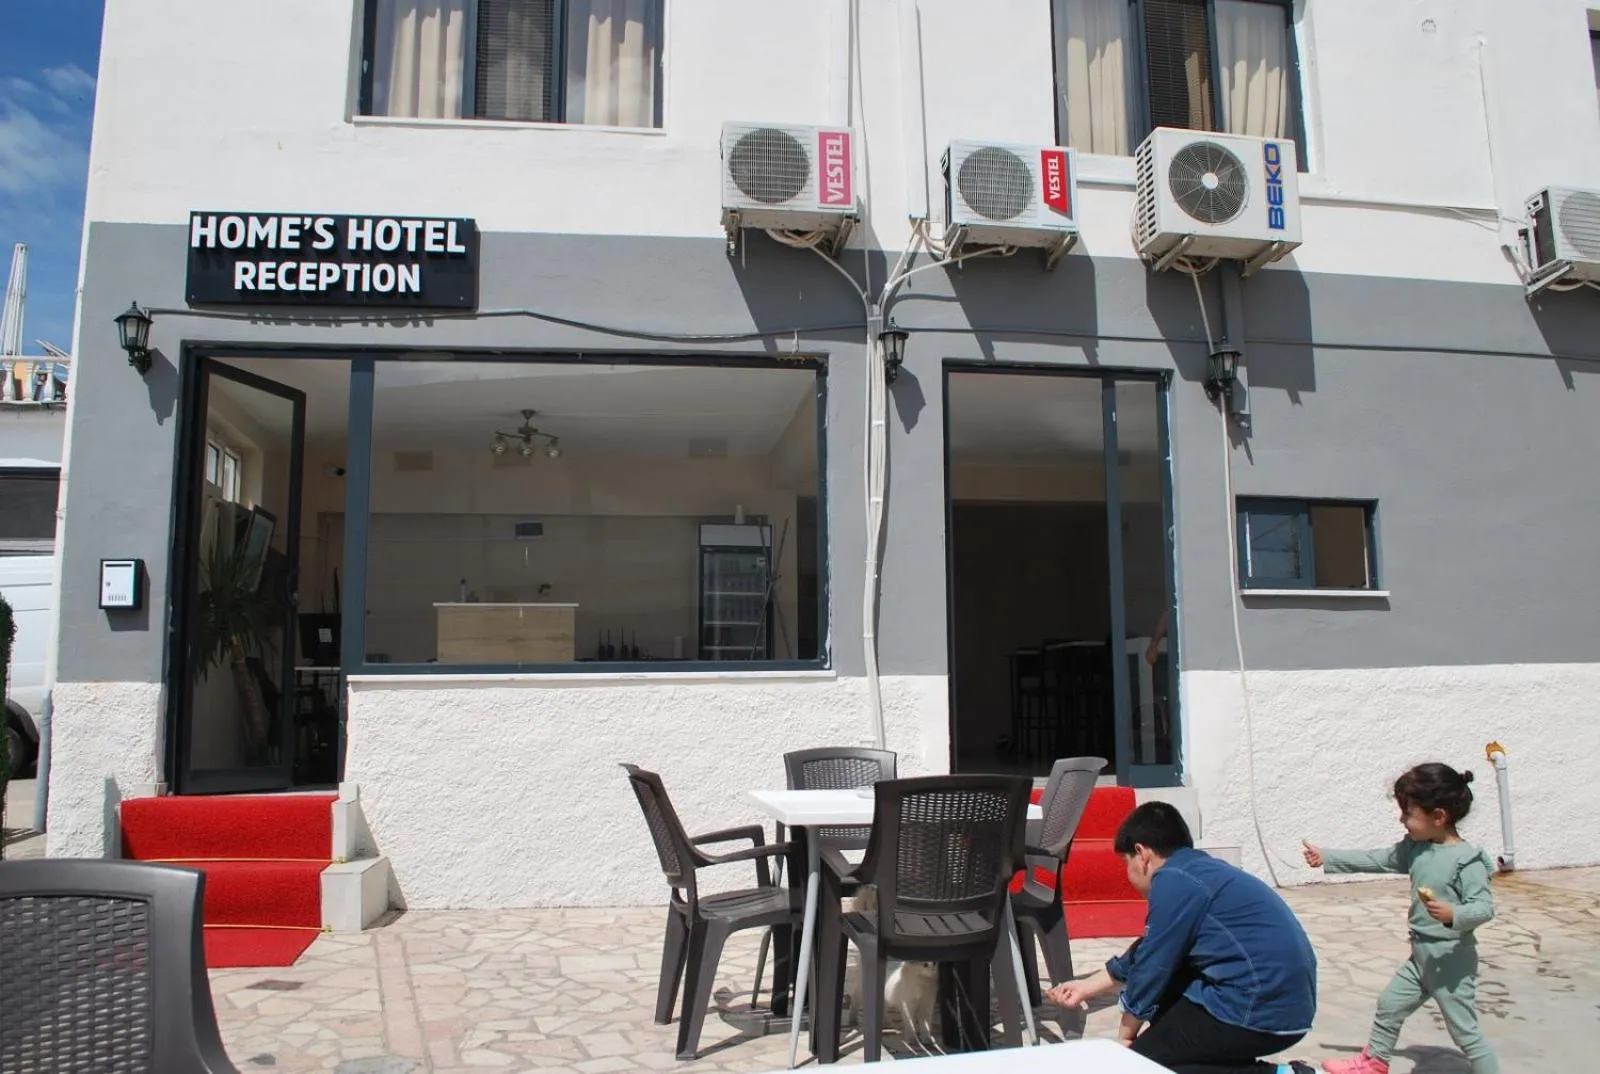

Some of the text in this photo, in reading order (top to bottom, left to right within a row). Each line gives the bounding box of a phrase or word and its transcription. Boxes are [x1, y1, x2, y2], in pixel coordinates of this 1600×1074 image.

[826, 134, 845, 203] VESTEL
[1047, 156, 1061, 200] VESTEL
[1264, 143, 1284, 229] BEKO
[191, 215, 466, 253] HOME'S HOTEL
[234, 261, 421, 293] RECEPTION
